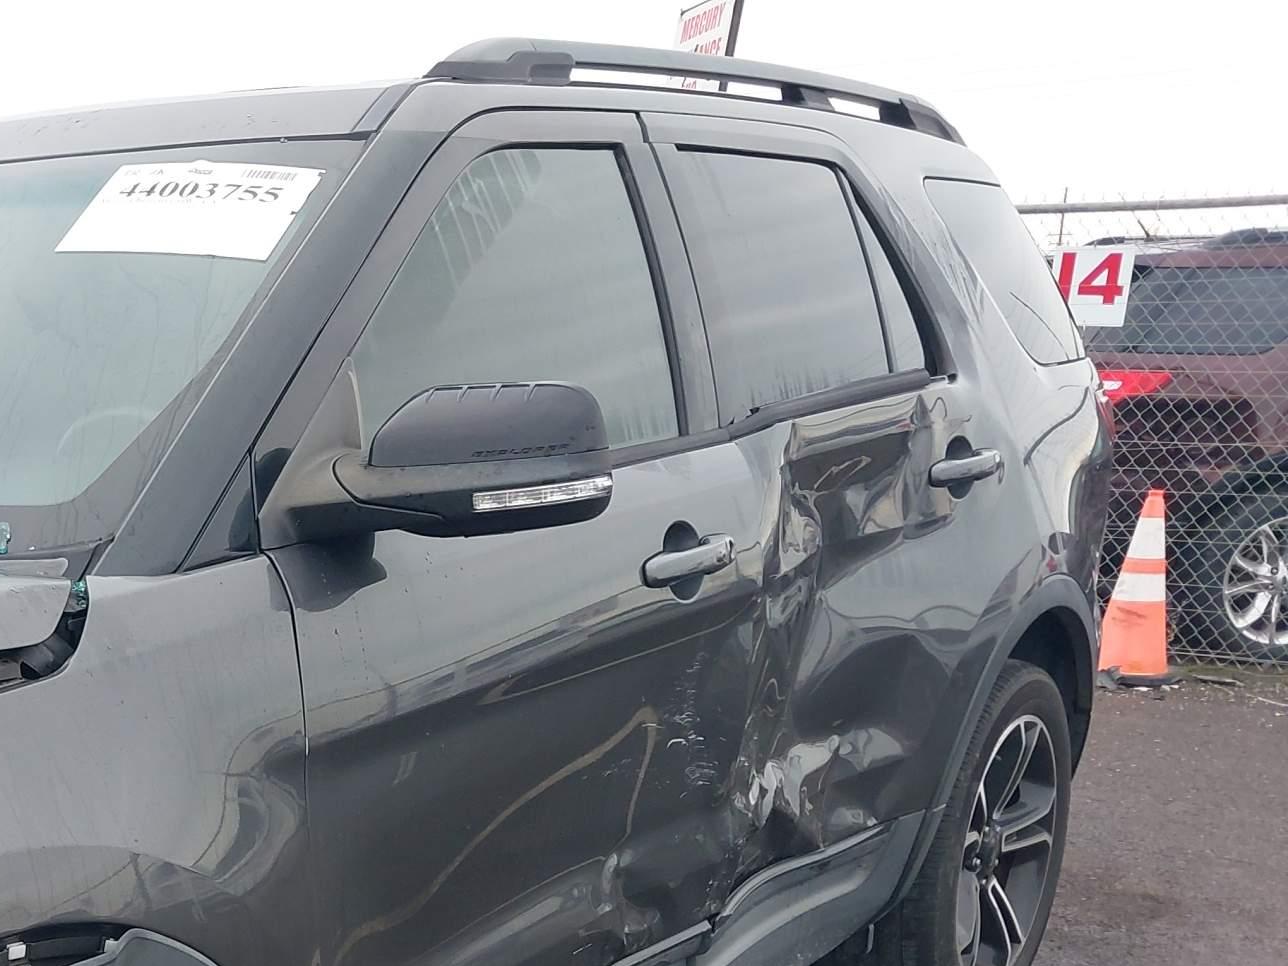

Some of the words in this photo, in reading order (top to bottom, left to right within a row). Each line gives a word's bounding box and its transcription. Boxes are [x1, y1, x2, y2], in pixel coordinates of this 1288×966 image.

[680, 2, 726, 44] MERCURY
[120, 180, 285, 203] 44003755
[1057, 252, 1124, 306] 14
[472, 443, 570, 458] EXPLORER
